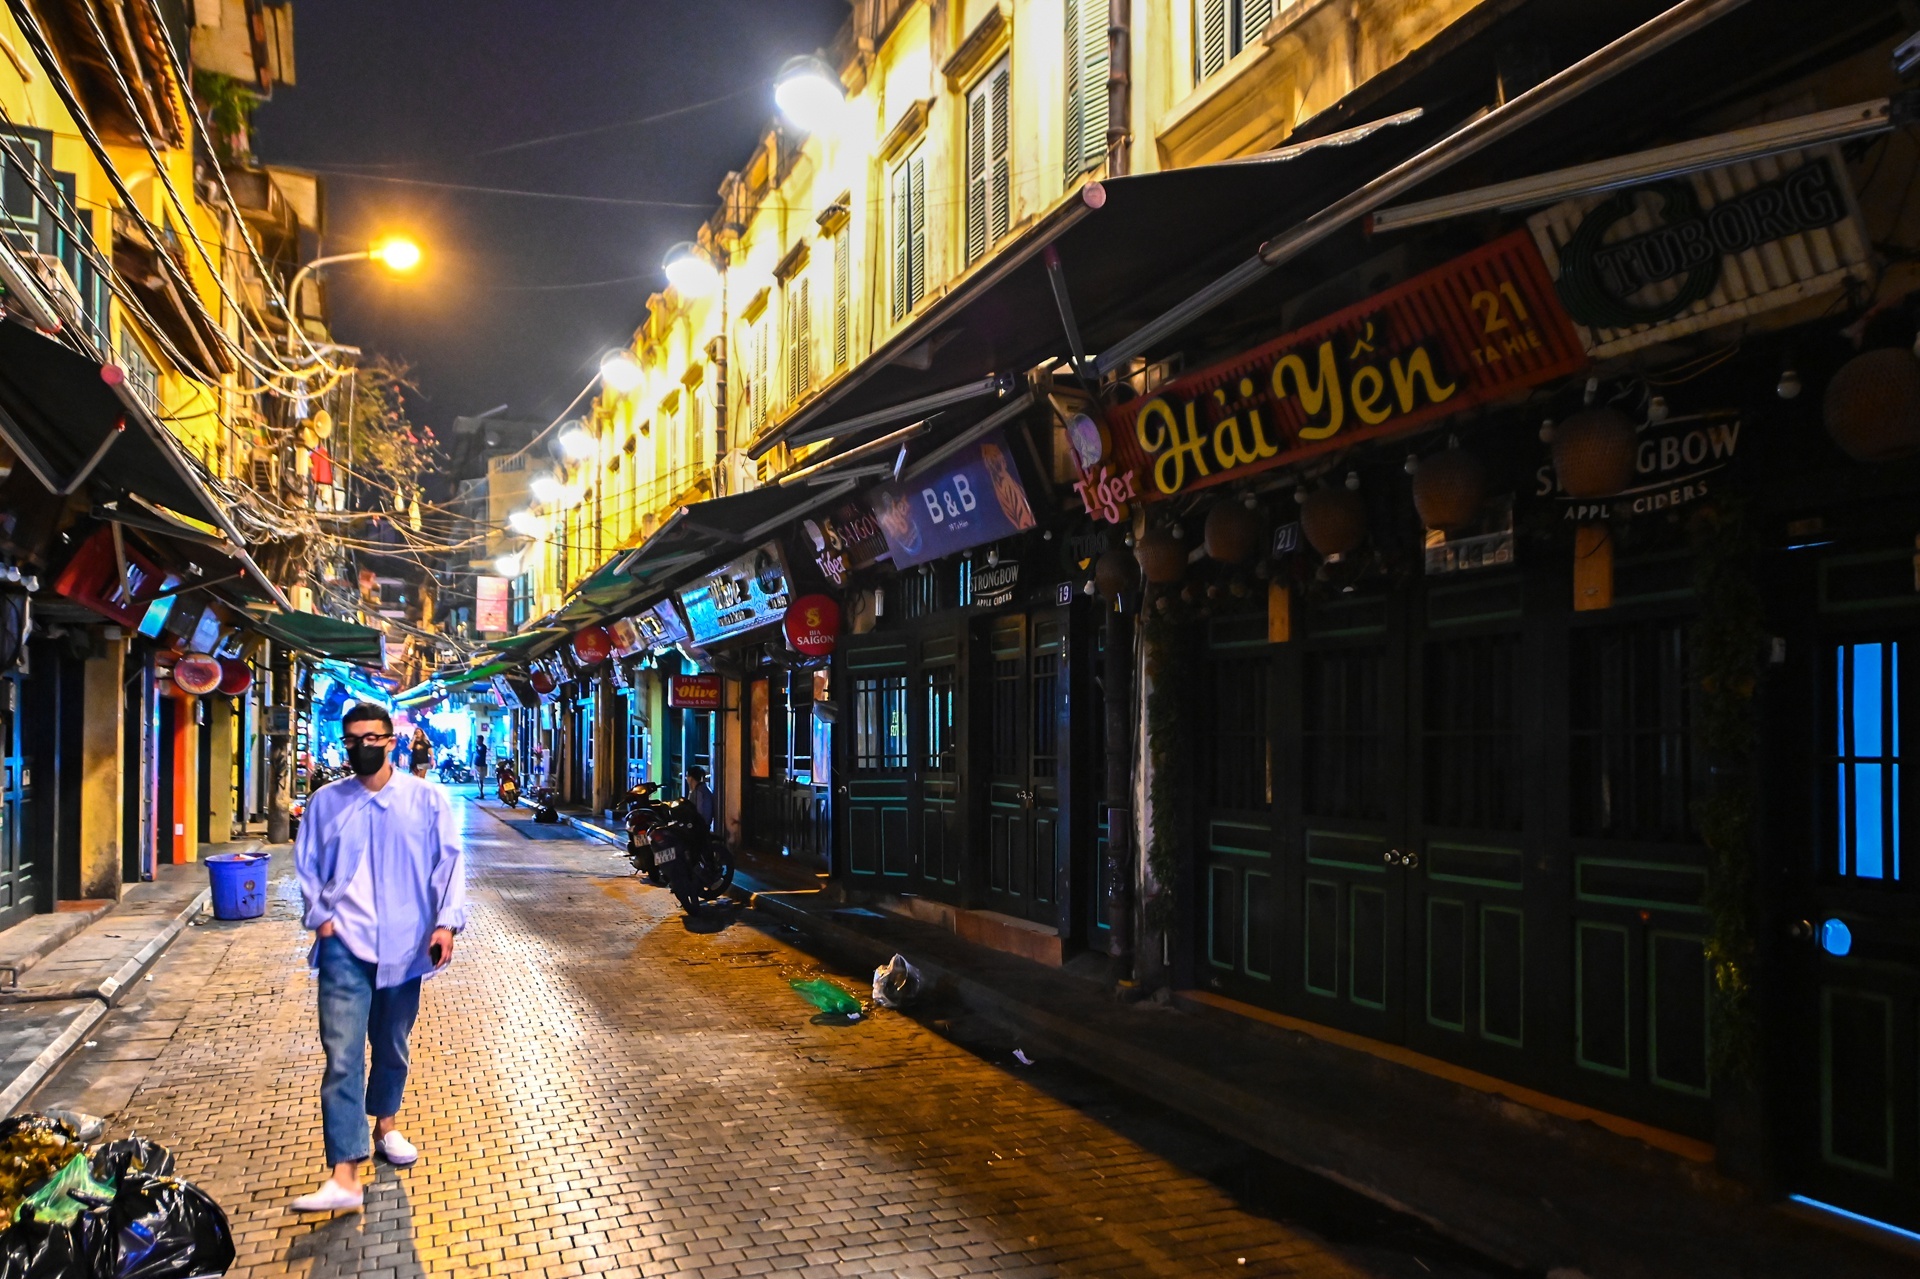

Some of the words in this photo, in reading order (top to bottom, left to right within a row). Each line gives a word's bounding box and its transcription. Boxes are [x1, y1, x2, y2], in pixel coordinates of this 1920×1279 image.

[1593, 162, 1839, 296] TUBORG
[1471, 281, 1529, 333] 21
[1536, 420, 1741, 497] SGBOW
[922, 488, 944, 524] B
[943, 490, 960, 517] &
[953, 473, 976, 512] B
[1073, 465, 1136, 524] Tiger
[1563, 504, 1611, 520] APPL
[1632, 480, 1708, 513] CIDERS
[1276, 527, 1292, 550] 21
[815, 551, 846, 584] Tiger
[969, 564, 1019, 593] STRONGBOW
[977, 598, 992, 607] APPLE
[993, 591, 1013, 606] CIDERS
[1059, 585, 1069, 602] 19
[796, 634, 835, 645] SAIGON
[675, 685, 718, 698] Olive
